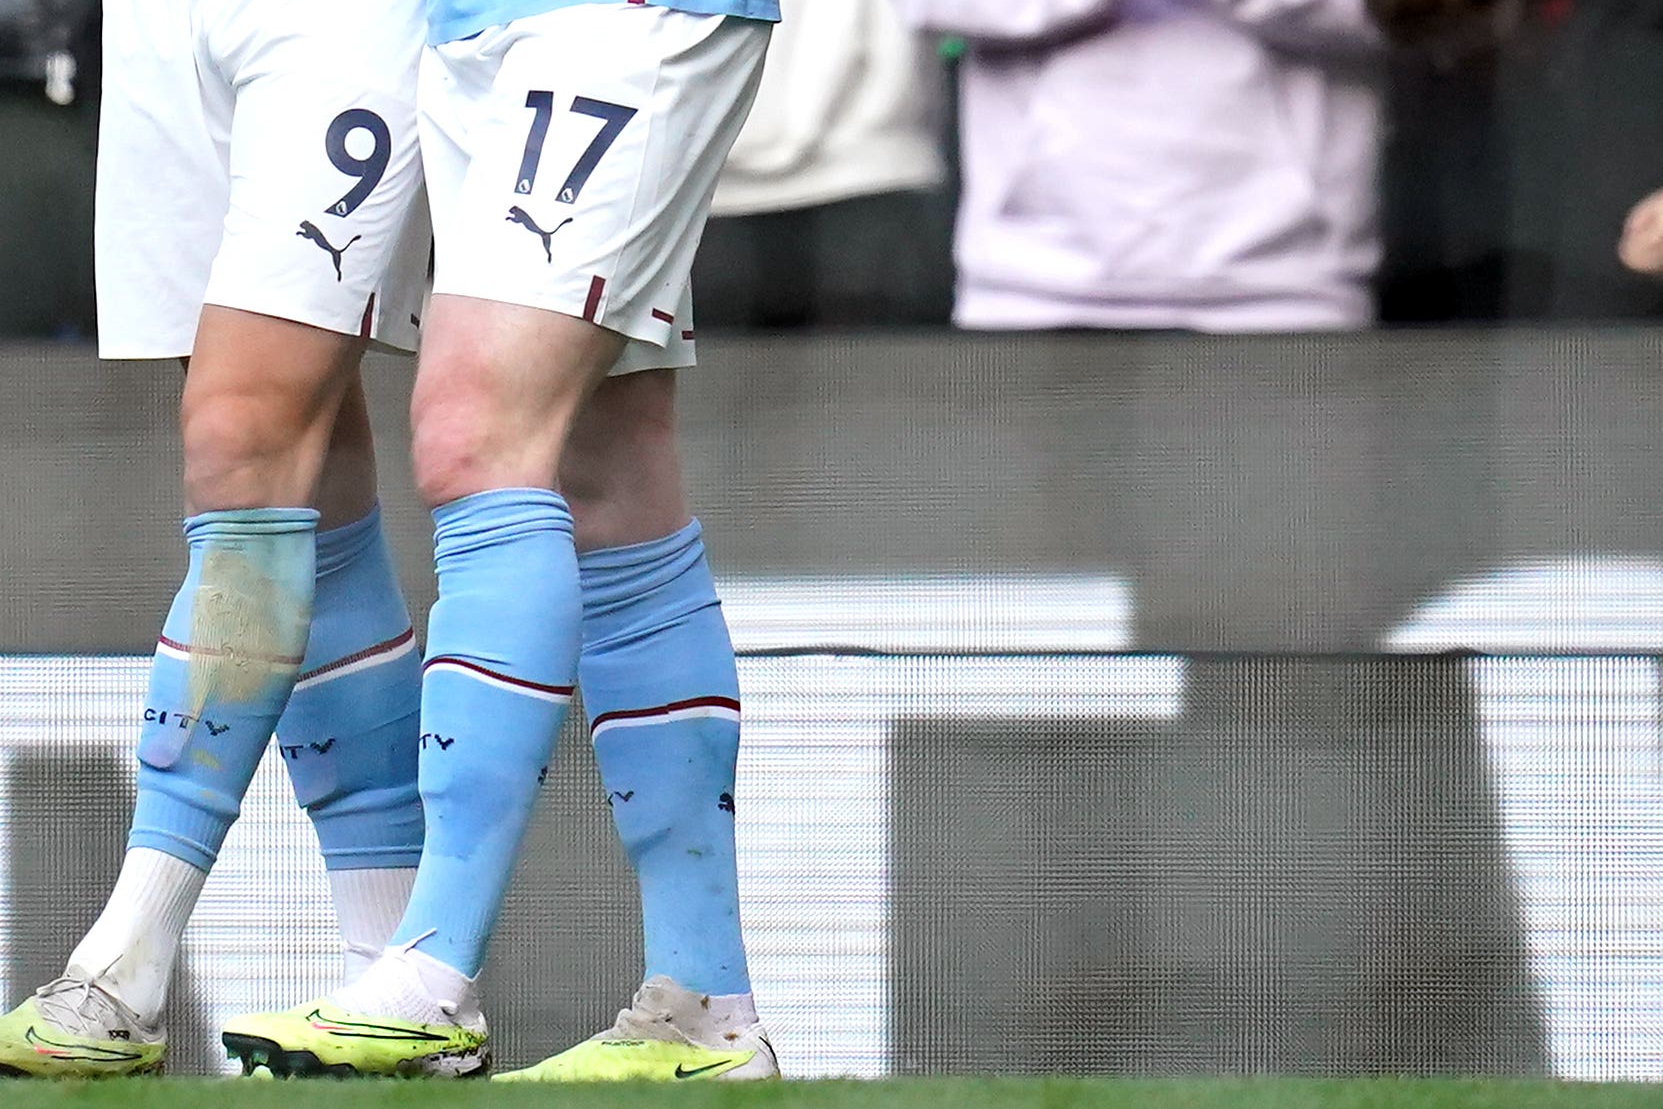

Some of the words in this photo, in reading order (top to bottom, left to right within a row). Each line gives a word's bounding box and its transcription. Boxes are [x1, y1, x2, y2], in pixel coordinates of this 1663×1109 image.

[514, 89, 639, 204] 17
[324, 107, 392, 218] 9
[144, 708, 230, 736] CITY
[279, 737, 335, 760] ITY
[419, 733, 454, 751] TY
